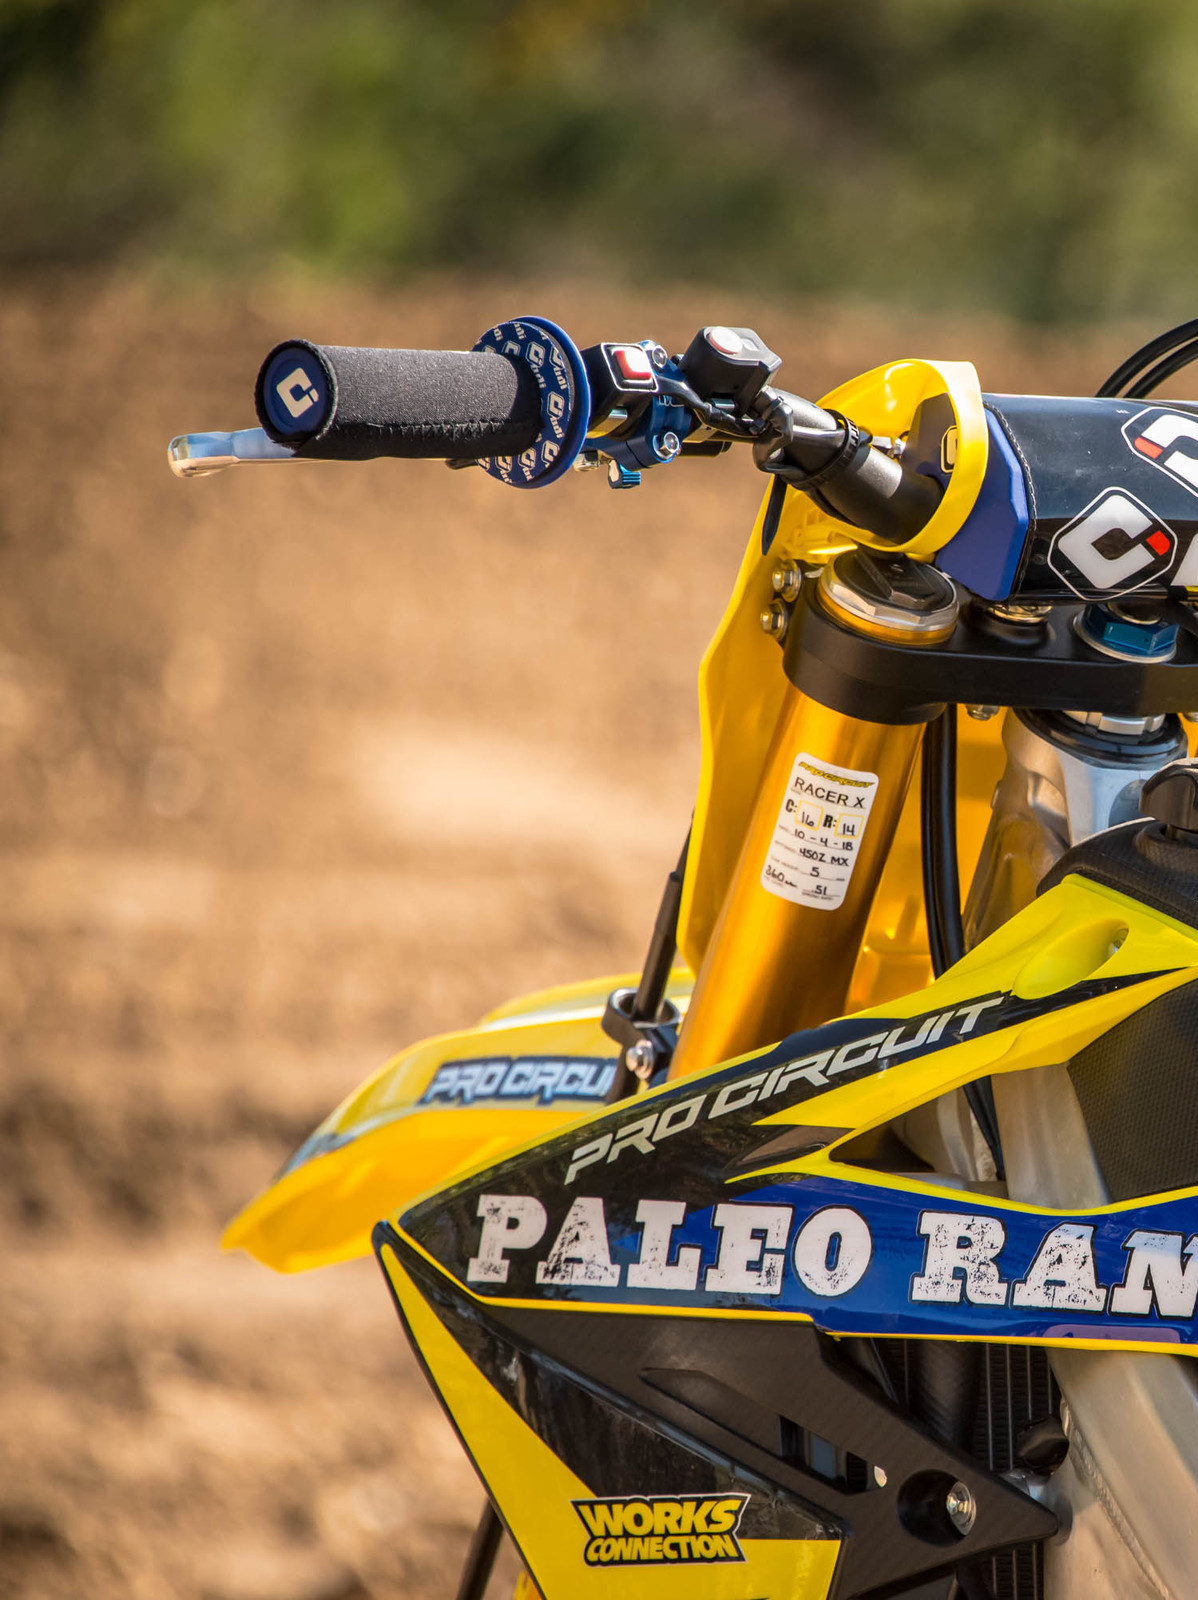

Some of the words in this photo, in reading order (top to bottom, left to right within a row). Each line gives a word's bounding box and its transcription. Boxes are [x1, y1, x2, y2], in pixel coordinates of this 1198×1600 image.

[794, 776, 850, 807] RACER
[852, 796, 866, 809] X
[822, 814, 838, 829] R:
[842, 823, 856, 837] 14
[830, 855, 850, 868] MX
[842, 841, 854, 852] 18
[809, 867, 821, 879] 5
[424, 1062, 512, 1104] PRO
[563, 1094, 707, 1186] PRO
[707, 996, 1005, 1121] CIRCUIT
[466, 1193, 874, 1298] PALEO
[577, 1499, 742, 1537] WORKS
[585, 1533, 739, 1562] CONNECTION
